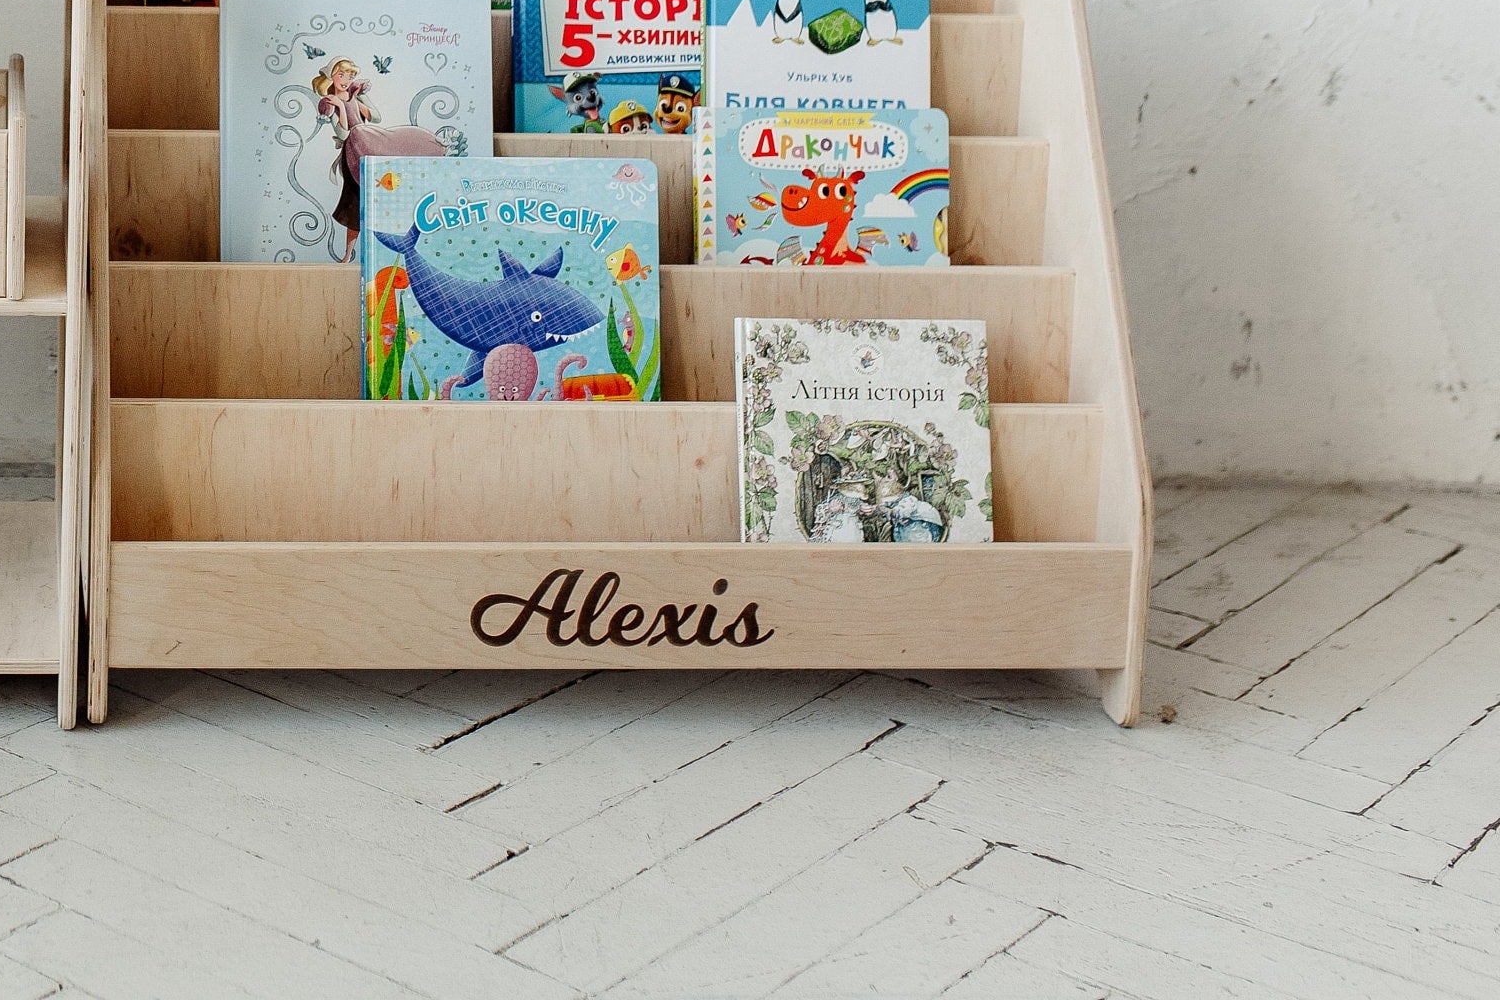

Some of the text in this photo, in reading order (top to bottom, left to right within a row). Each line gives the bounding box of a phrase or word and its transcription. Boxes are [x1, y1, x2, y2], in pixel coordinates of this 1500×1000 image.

[419, 22, 448, 36] Disney
[607, 54, 676, 65] ДИВОВИЖНІ
[414, 192, 618, 250] Світ океану
[791, 379, 945, 408] Літня історія
[469, 568, 775, 647] Alexis
